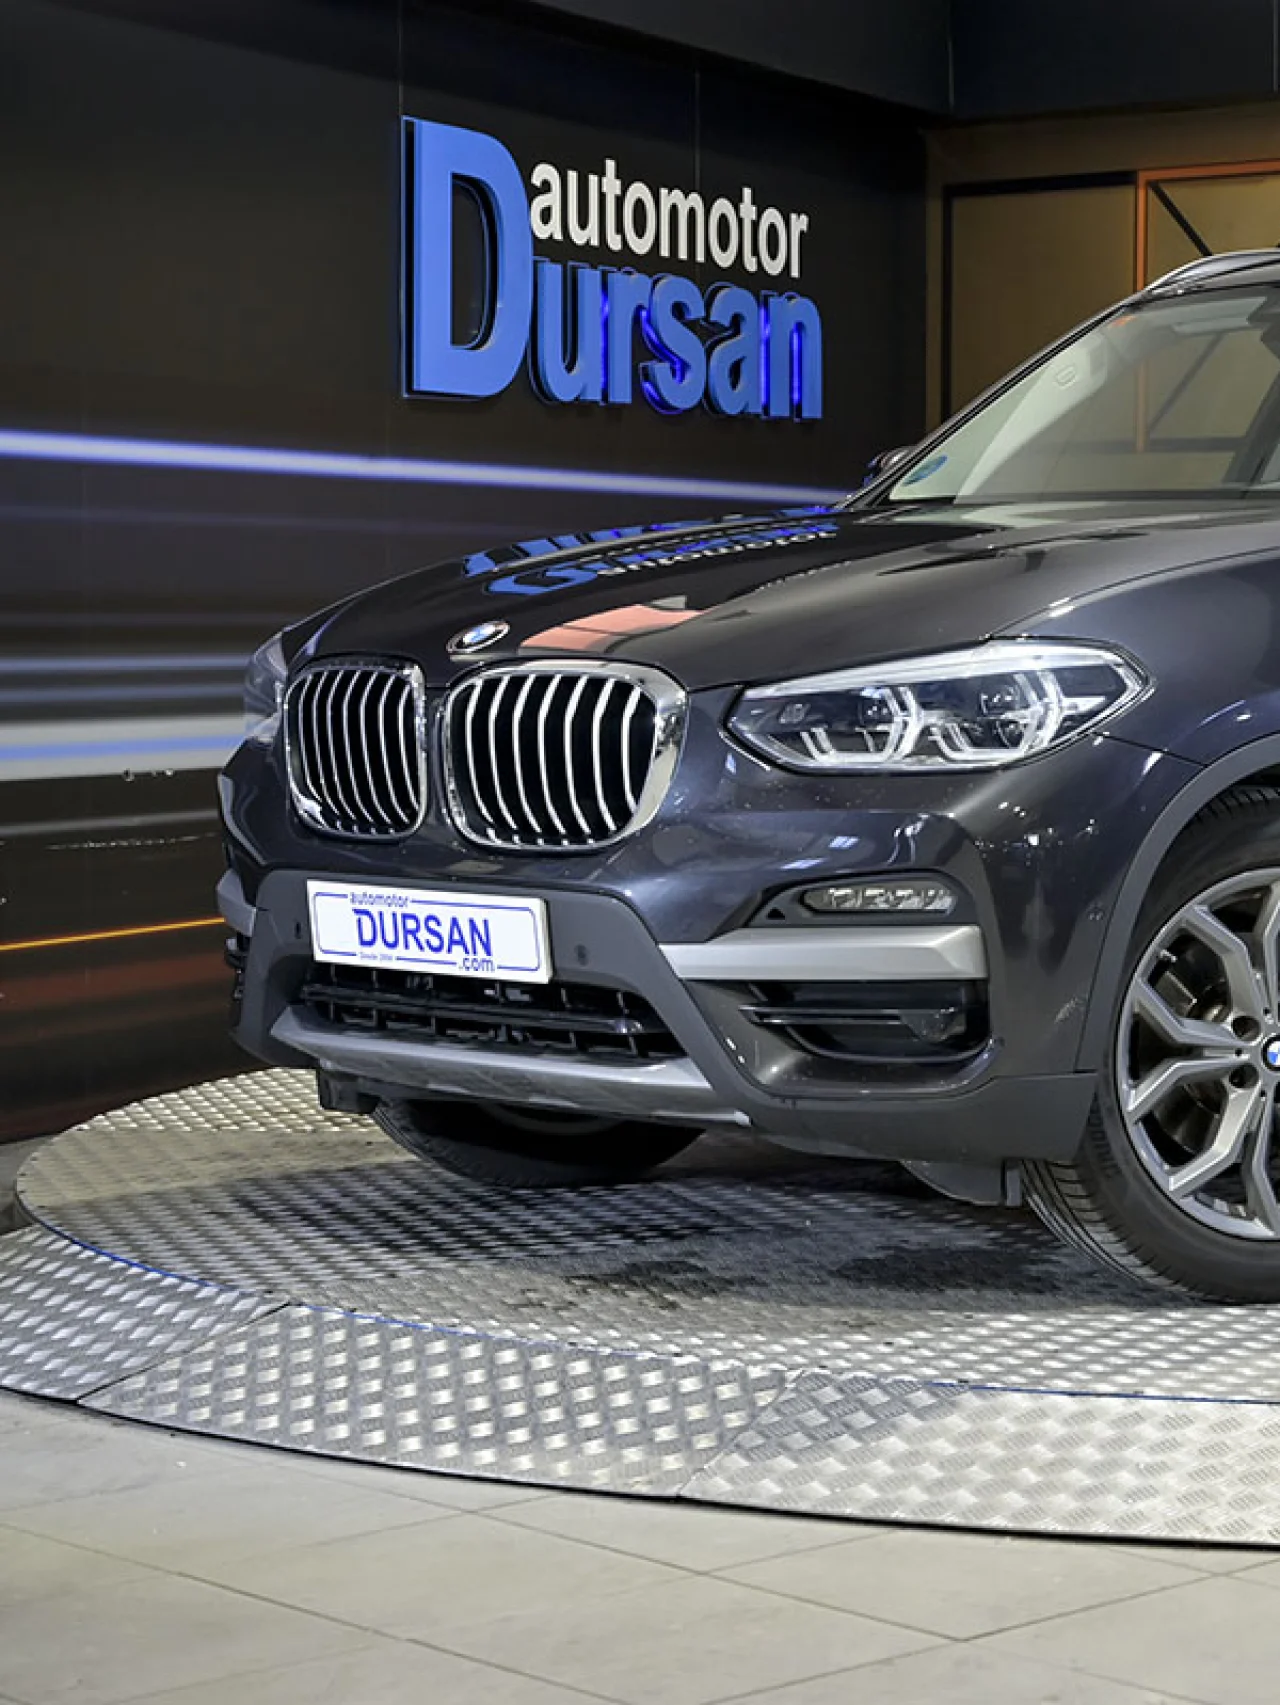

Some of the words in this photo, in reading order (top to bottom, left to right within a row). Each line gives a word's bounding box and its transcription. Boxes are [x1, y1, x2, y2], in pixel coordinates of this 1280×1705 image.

[402, 115, 823, 421] Dursan
[529, 158, 809, 279] automotor
[352, 908, 493, 957] DURSAN
